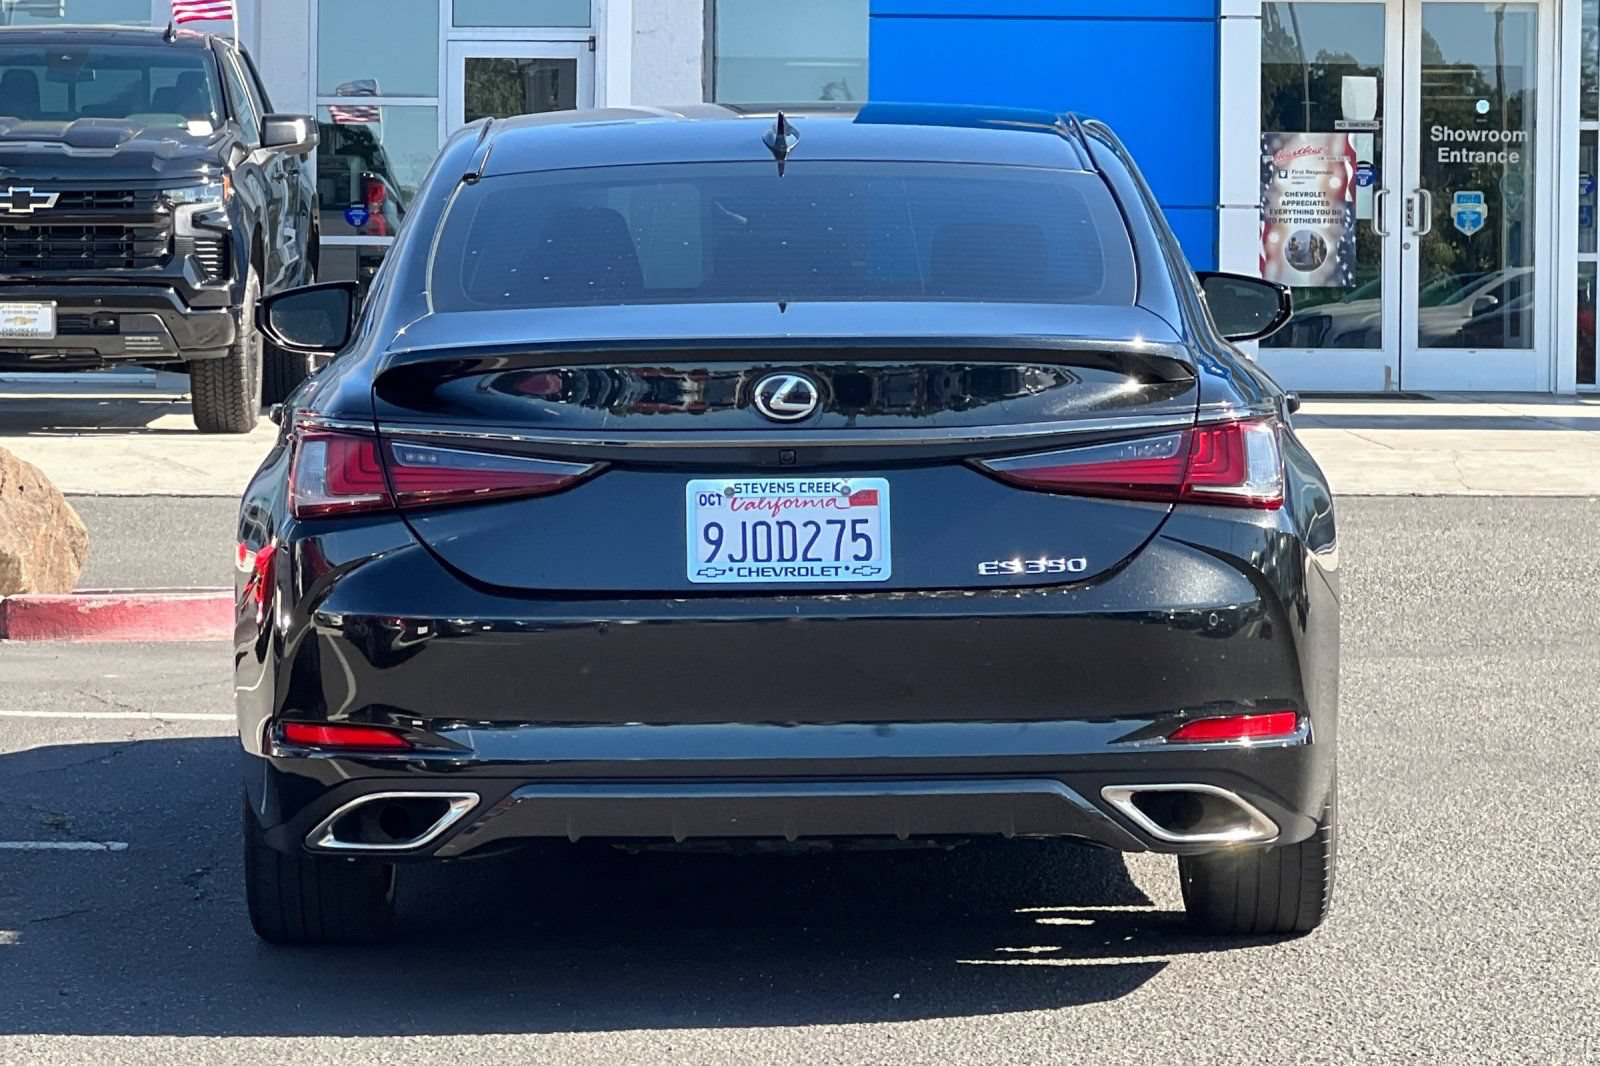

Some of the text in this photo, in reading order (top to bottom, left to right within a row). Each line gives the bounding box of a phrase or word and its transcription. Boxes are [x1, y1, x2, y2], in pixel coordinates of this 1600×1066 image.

[1430, 125, 1529, 142] Showroom
[1437, 147, 1520, 163] Entrance
[733, 481, 842, 494] STEVENS CREEK
[699, 493, 723, 507] OCT
[730, 497, 849, 517] California
[736, 566, 842, 578] CHEVROLET
